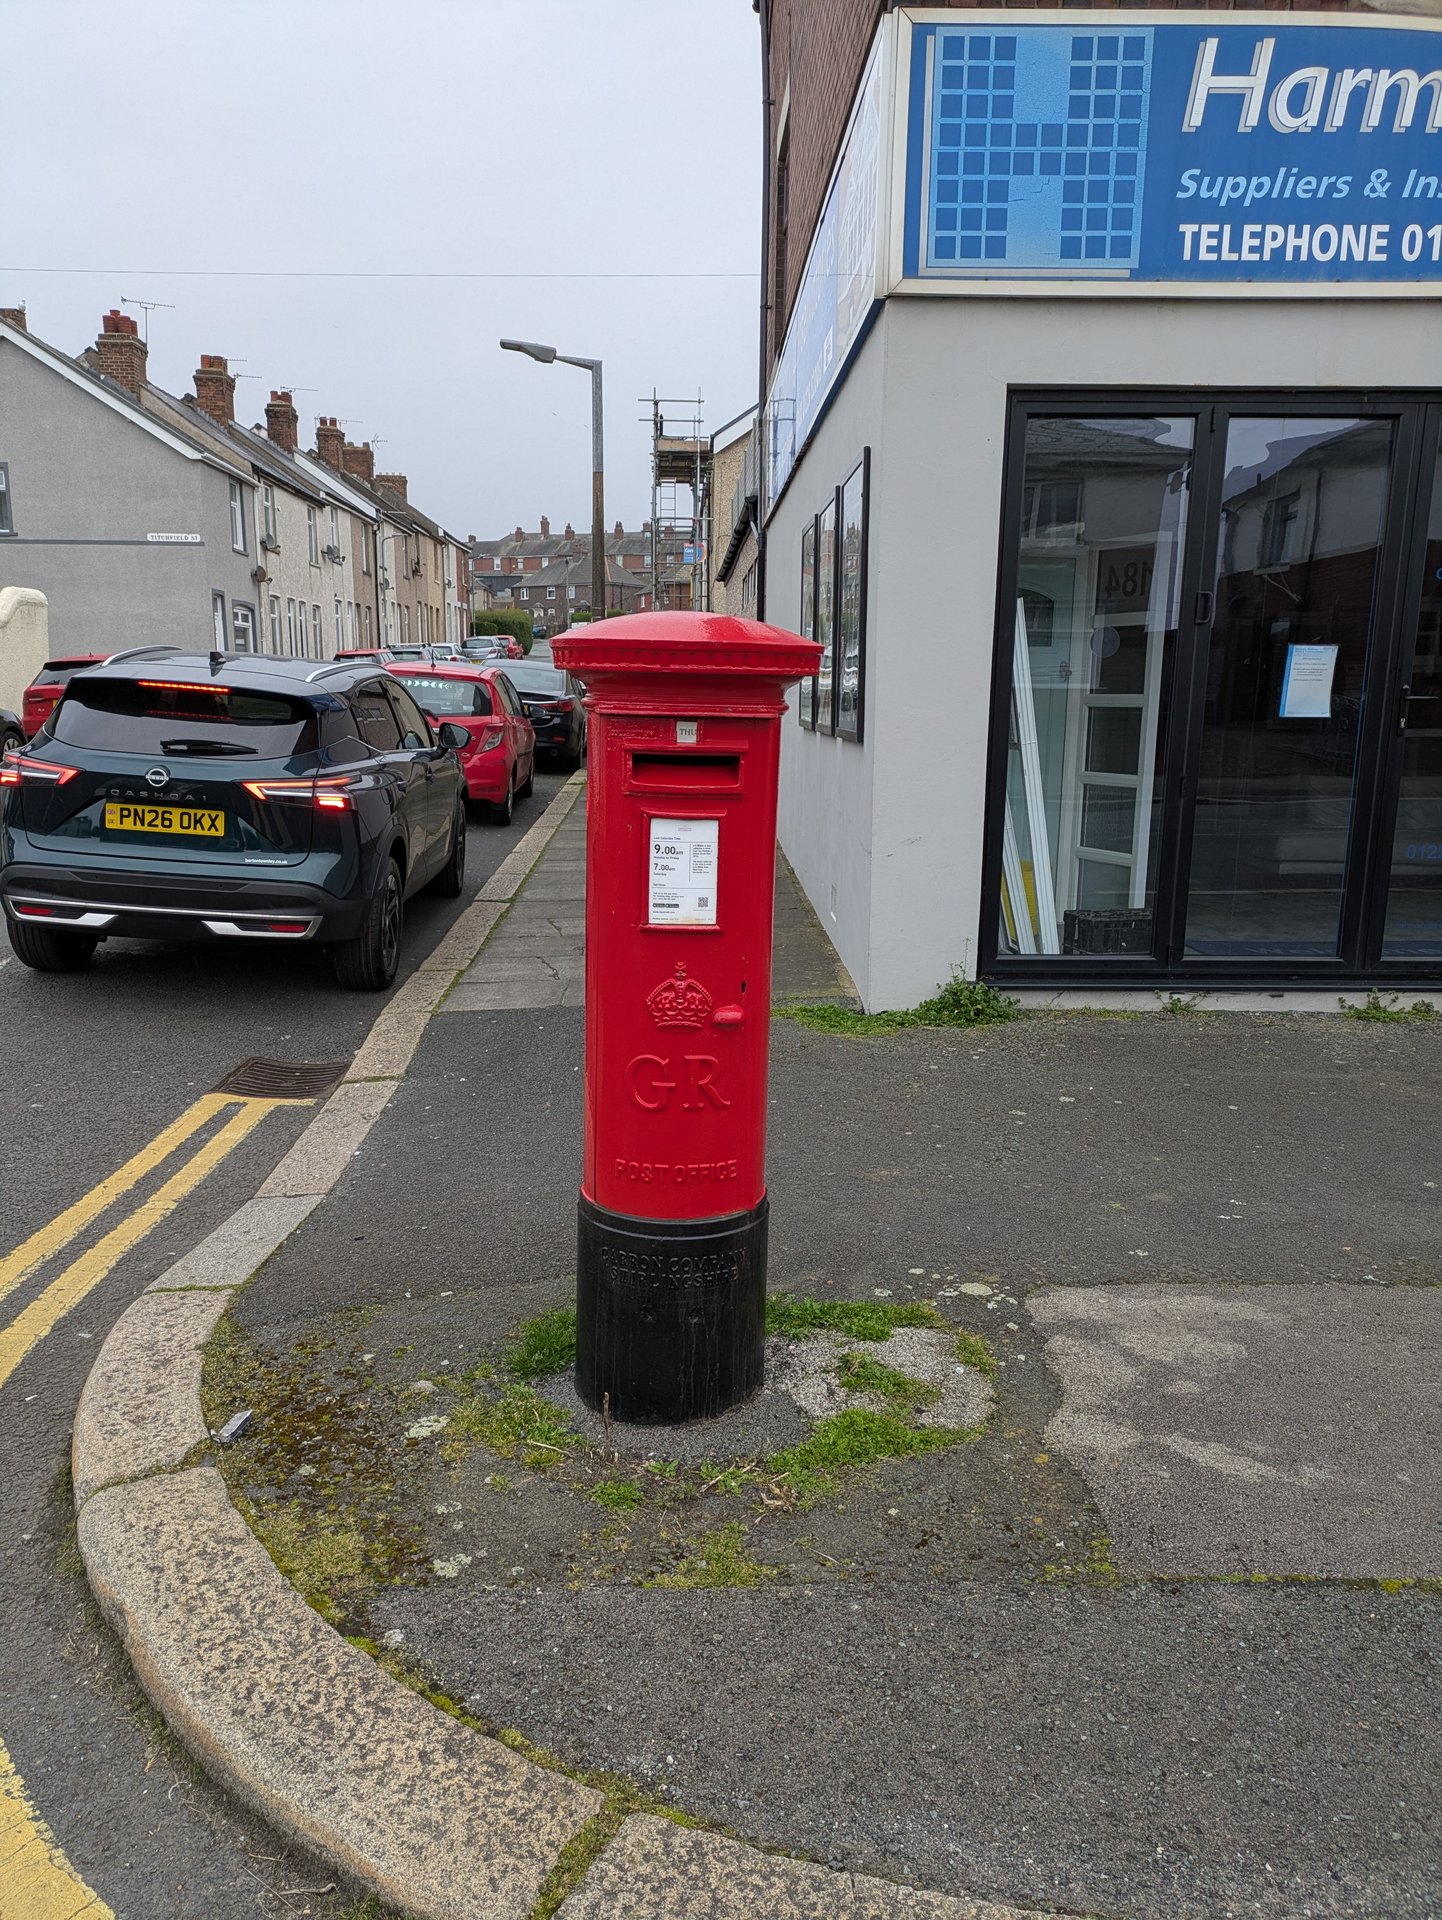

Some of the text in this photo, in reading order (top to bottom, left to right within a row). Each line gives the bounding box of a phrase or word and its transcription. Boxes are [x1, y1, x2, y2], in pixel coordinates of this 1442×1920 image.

[1176, 167, 1442, 207] Suppliers & In
[1179, 223, 1442, 262] TELEPHONE 01
[679, 728, 697, 736] THU
[110, 788, 207, 801] QASHQAI
[119, 807, 219, 832] PN26 OKX
[654, 844, 683, 855] 9.00am
[1406, 843, 1442, 860] 012
[653, 863, 676, 871] 7.00am
[615, 1158, 737, 1186] POST OFFICE
[601, 1246, 747, 1271] CARRON COMPANY
